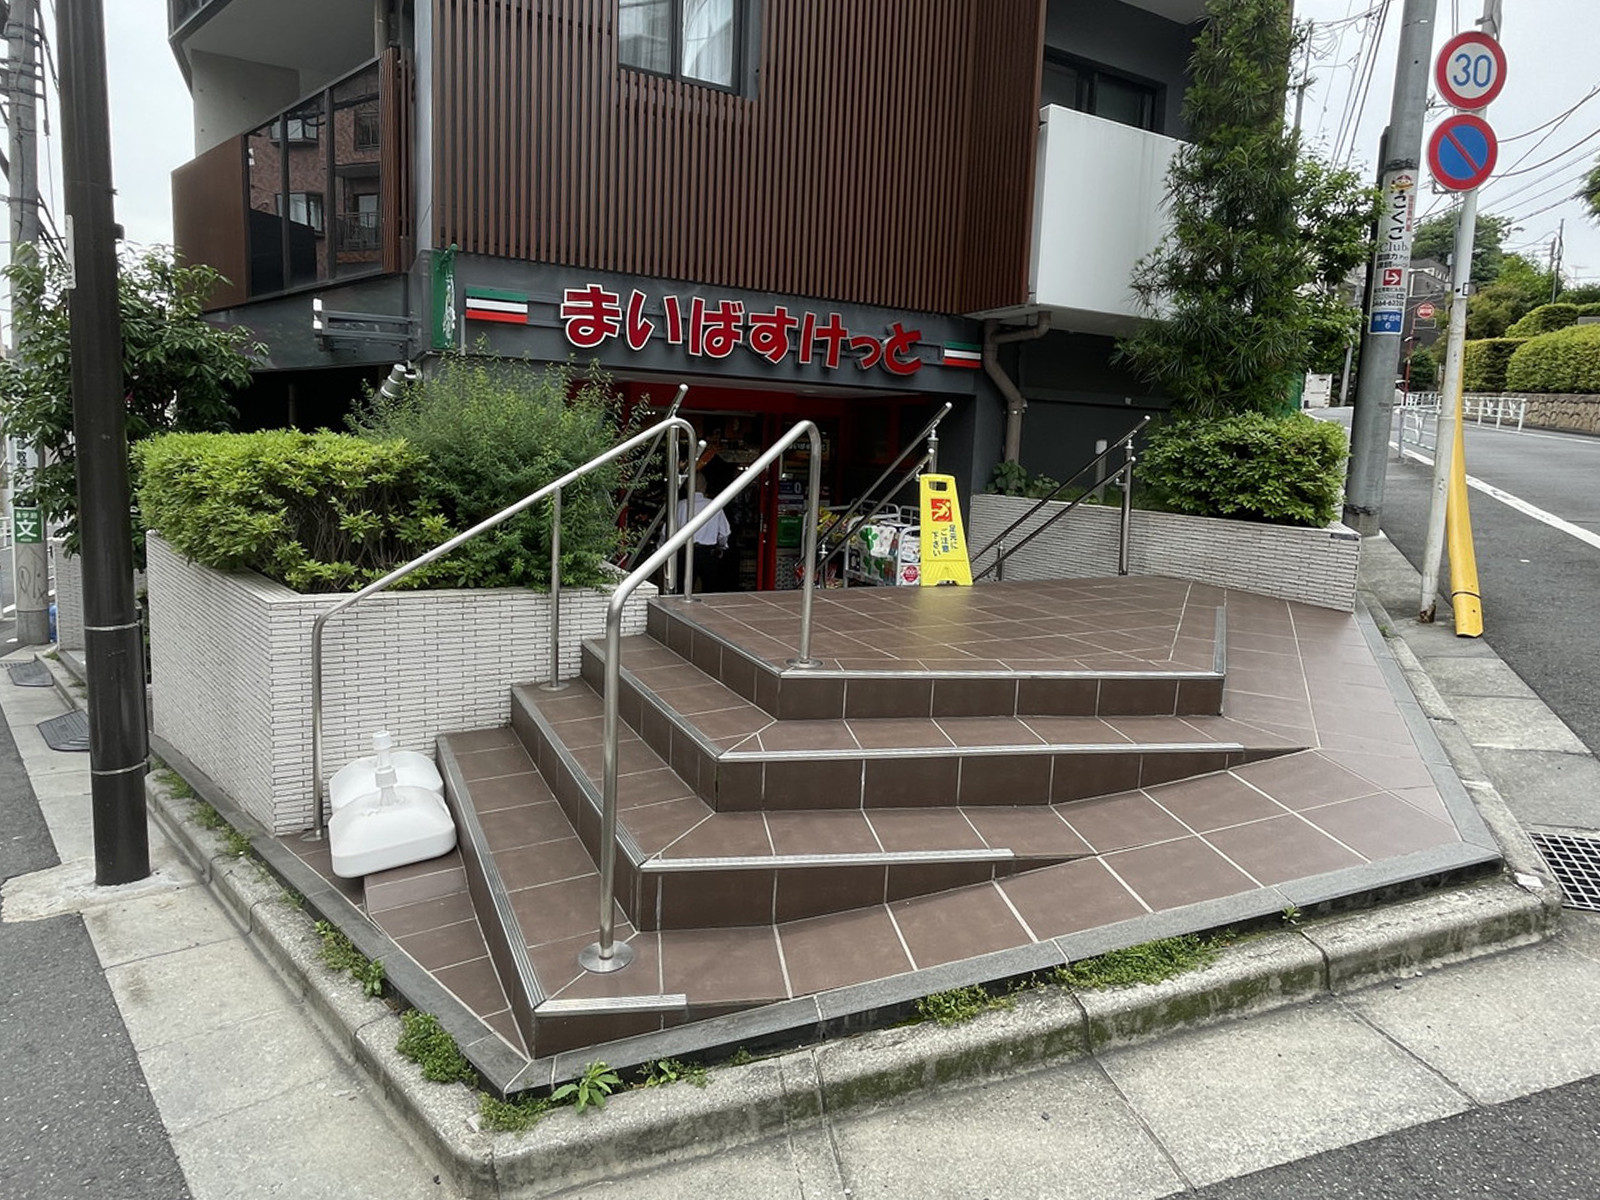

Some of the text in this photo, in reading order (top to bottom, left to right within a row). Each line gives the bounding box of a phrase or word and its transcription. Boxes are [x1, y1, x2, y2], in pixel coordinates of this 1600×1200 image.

[1453, 53, 1492, 88] 30
[1379, 241, 1408, 253] Club
[560, 284, 922, 376] まいばすけっと
[1384, 321, 1392, 330] 6
[16, 518, 38, 537] 文
